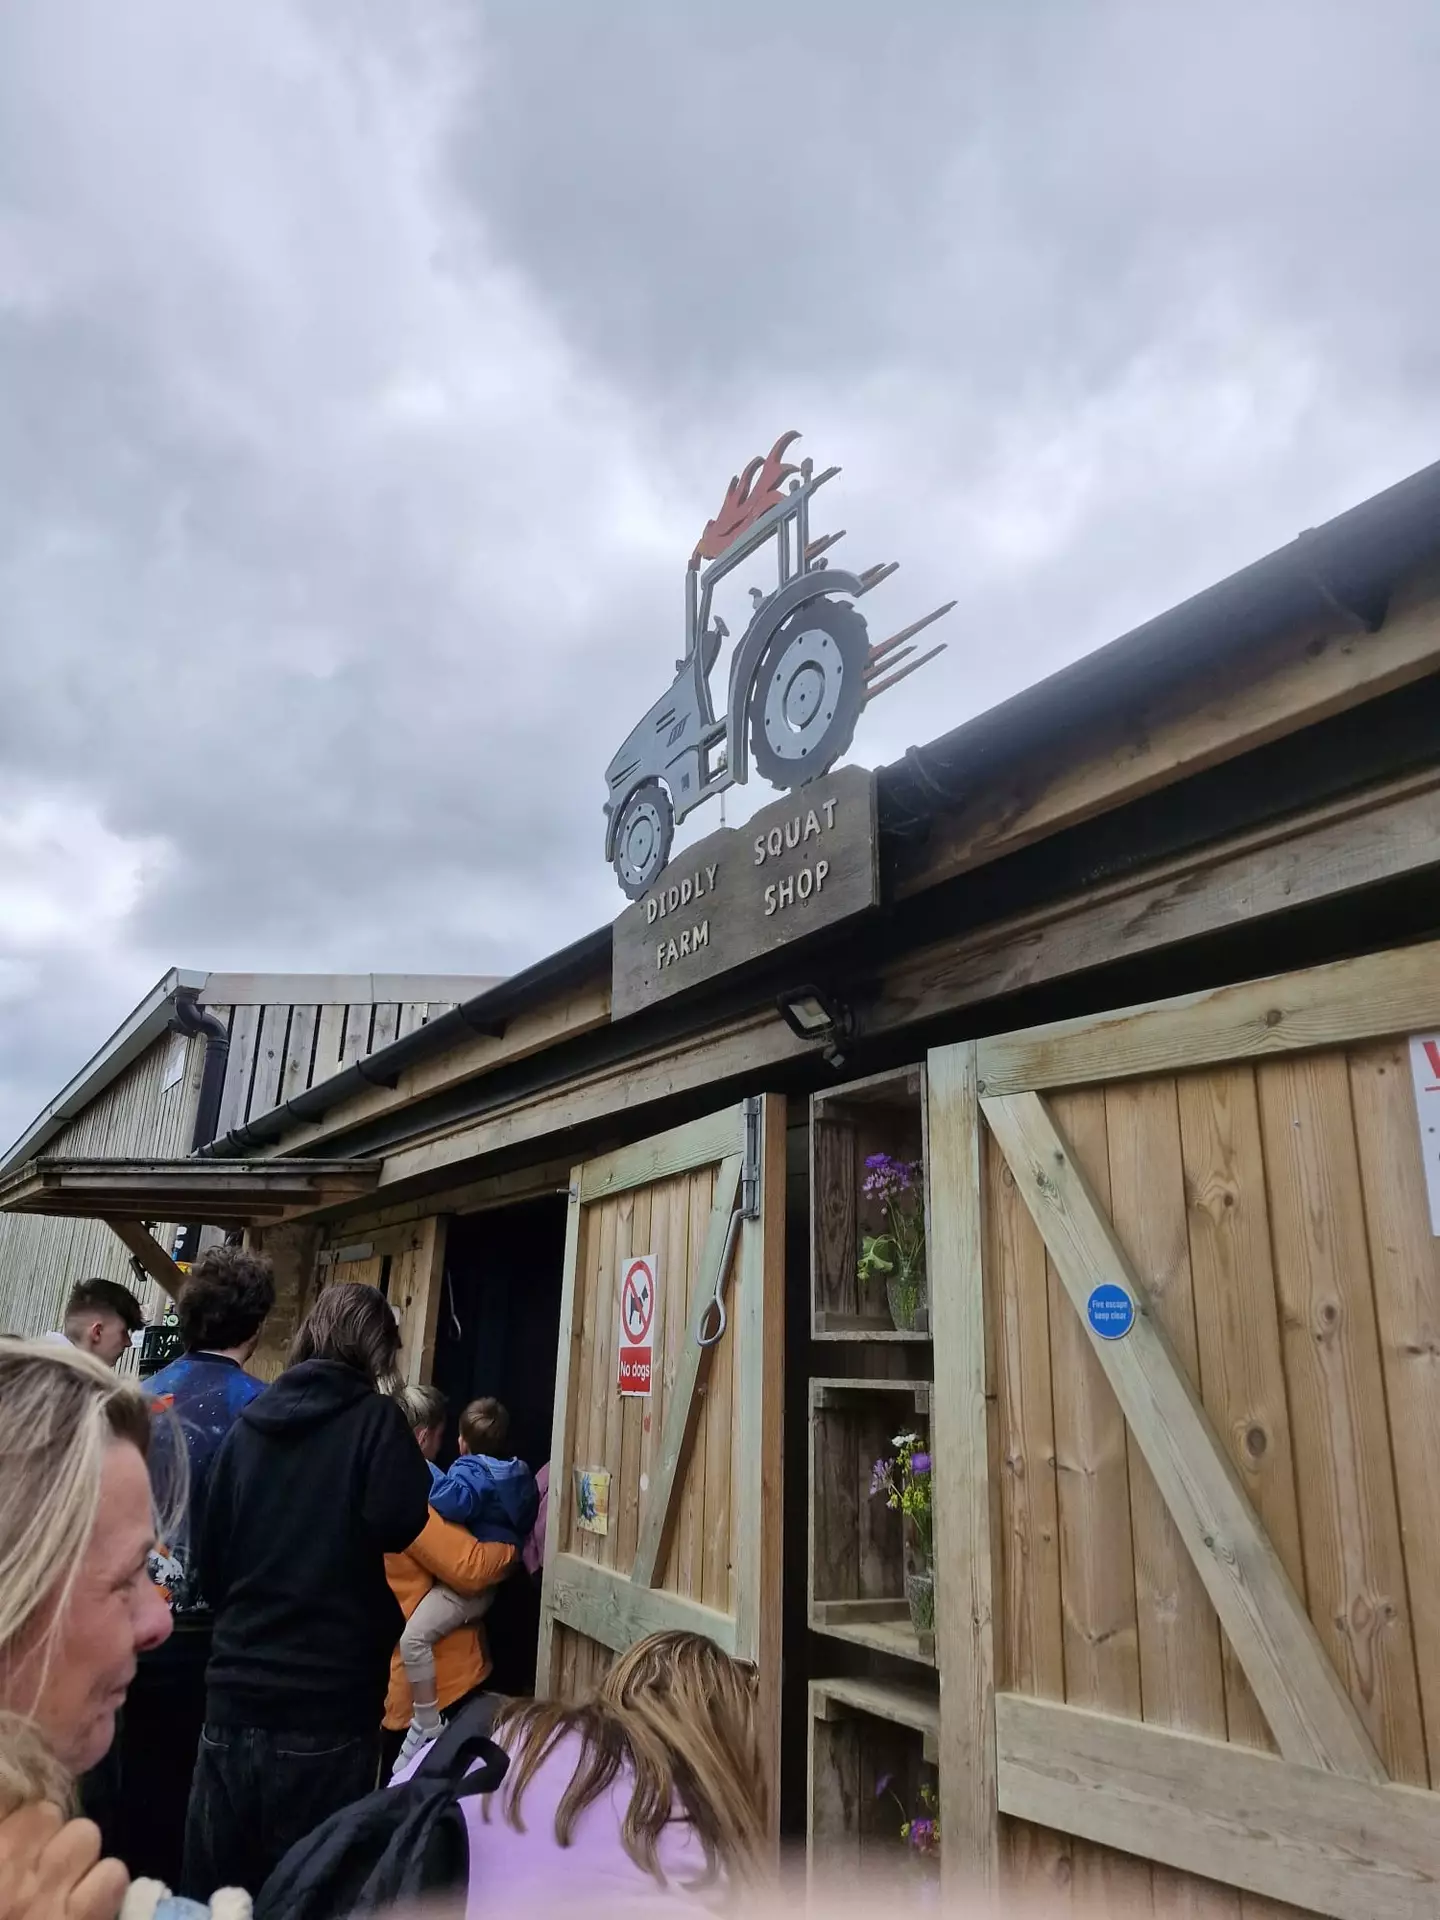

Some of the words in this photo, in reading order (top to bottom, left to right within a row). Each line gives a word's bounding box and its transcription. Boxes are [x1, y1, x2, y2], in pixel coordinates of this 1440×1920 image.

[646, 863, 719, 925] DIDDLY
[753, 797, 838, 867] SQUAT
[655, 920, 711, 970] FARM
[764, 860, 830, 917] SHOP
[1092, 1300, 1105, 1309] Fire
[1105, 1301, 1128, 1310] escape
[1094, 1311, 1110, 1321] keep
[1110, 1311, 1127, 1320] clear
[620, 1360, 631, 1377] No
[632, 1361, 650, 1382] dogs
